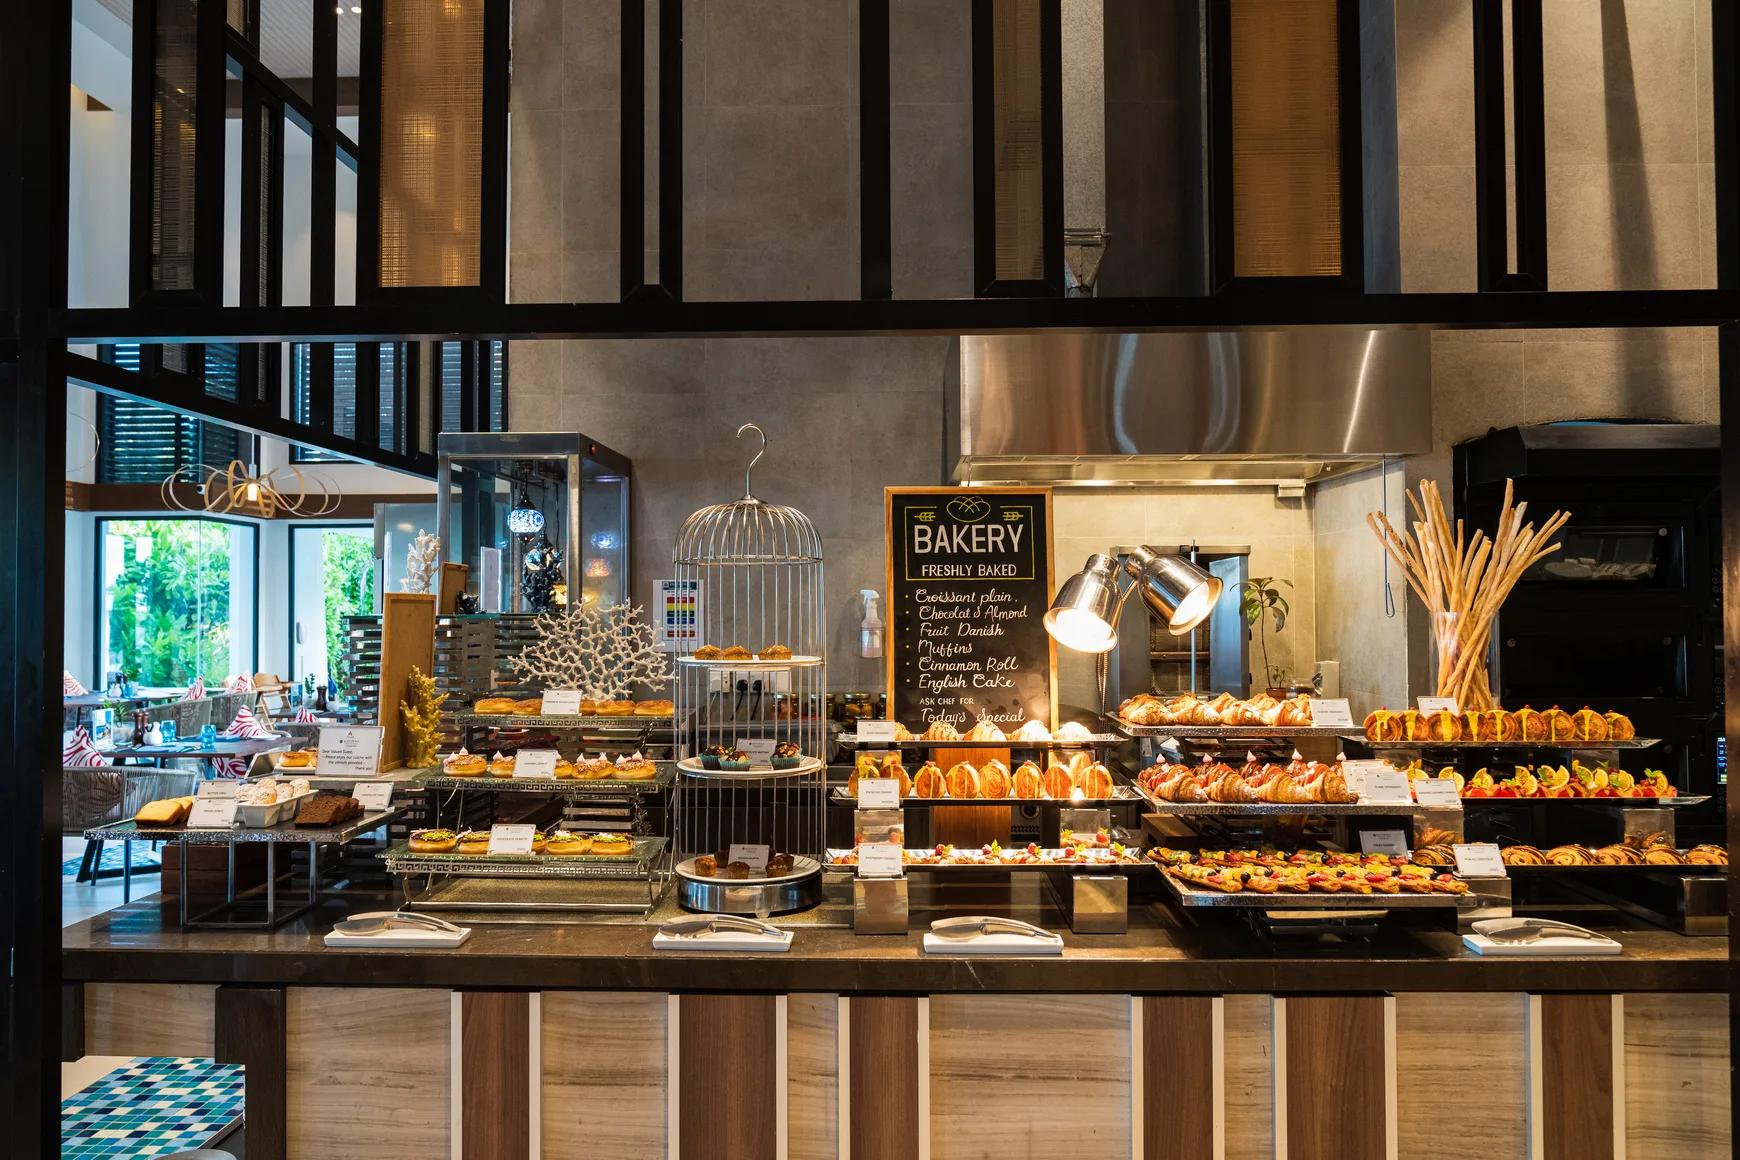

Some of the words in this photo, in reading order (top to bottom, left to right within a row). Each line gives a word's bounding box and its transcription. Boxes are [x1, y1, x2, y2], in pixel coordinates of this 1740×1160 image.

[914, 524, 1024, 554] BAKERY
[921, 564, 973, 577] FRESHLY
[978, 563, 1017, 576] BAKED
[915, 588, 976, 603] Croissant
[919, 605, 971, 620] Chocolat
[984, 605, 1028, 623] Almond
[919, 622, 950, 637] Fruit
[957, 622, 1005, 637] Danish
[918, 639, 973, 657] Muffins
[918, 656, 982, 672] Cinnamon
[986, 656, 1019, 671] Roll
[918, 673, 967, 694] English
[919, 697, 935, 705] ASK
[937, 697, 956, 705] CHEF
[959, 697, 974, 705] FOR
[976, 708, 1025, 724] Special
